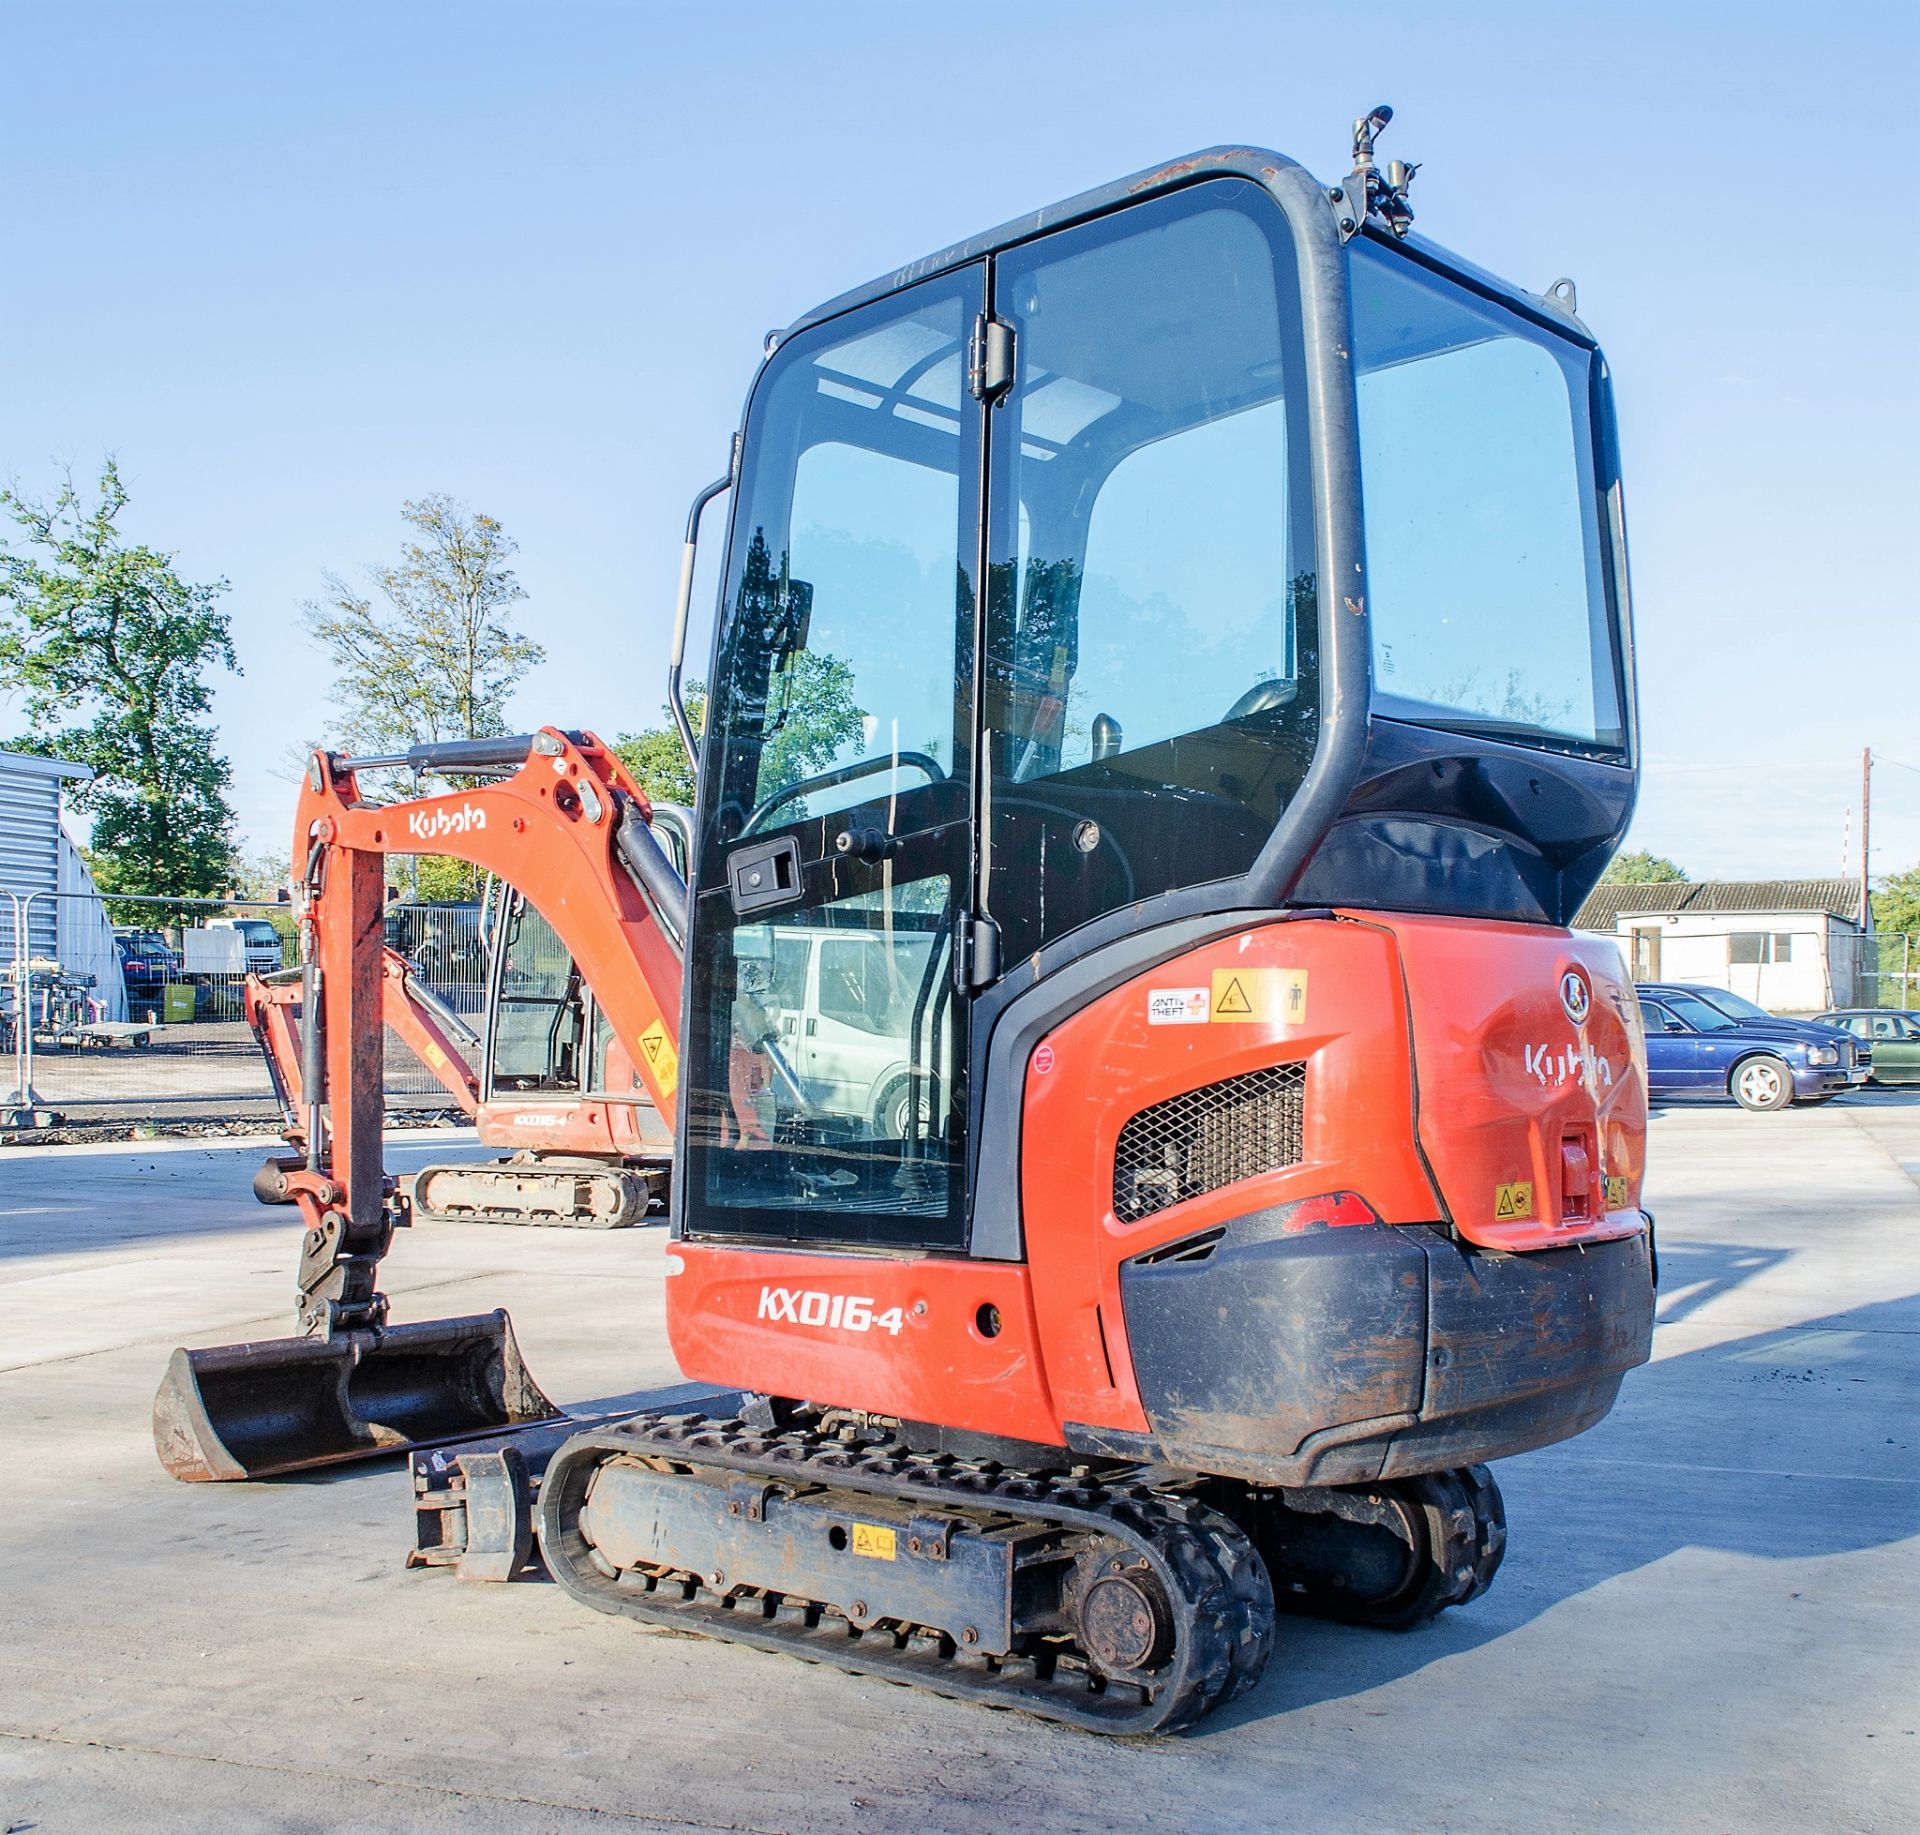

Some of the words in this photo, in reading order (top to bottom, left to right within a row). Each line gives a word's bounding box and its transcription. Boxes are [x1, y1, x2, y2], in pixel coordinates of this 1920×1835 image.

[409, 803, 487, 839] Kubota
[1151, 1007, 1184, 1016] THEFT
[757, 1286, 904, 1336] KX016-4
